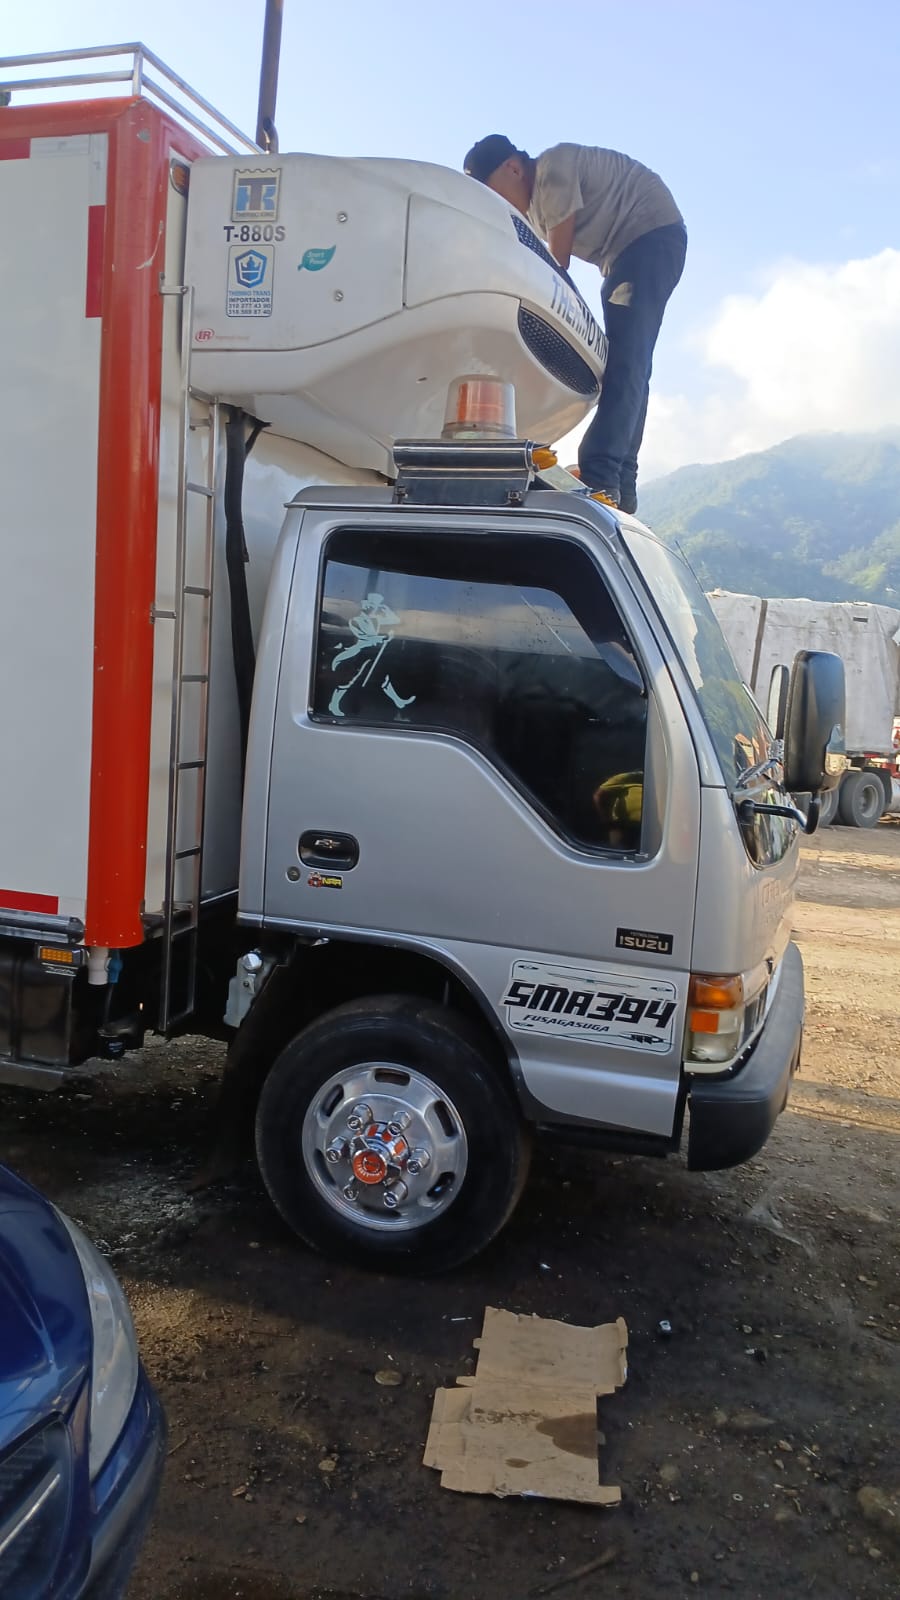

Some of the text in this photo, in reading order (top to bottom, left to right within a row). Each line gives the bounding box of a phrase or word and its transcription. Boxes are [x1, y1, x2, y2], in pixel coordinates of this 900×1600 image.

[223, 225, 286, 242] T-880S
[619, 935, 669, 951] ISUZU
[503, 981, 677, 1029] SMA394
[522, 1014, 610, 1032] FUSAGASUGA
